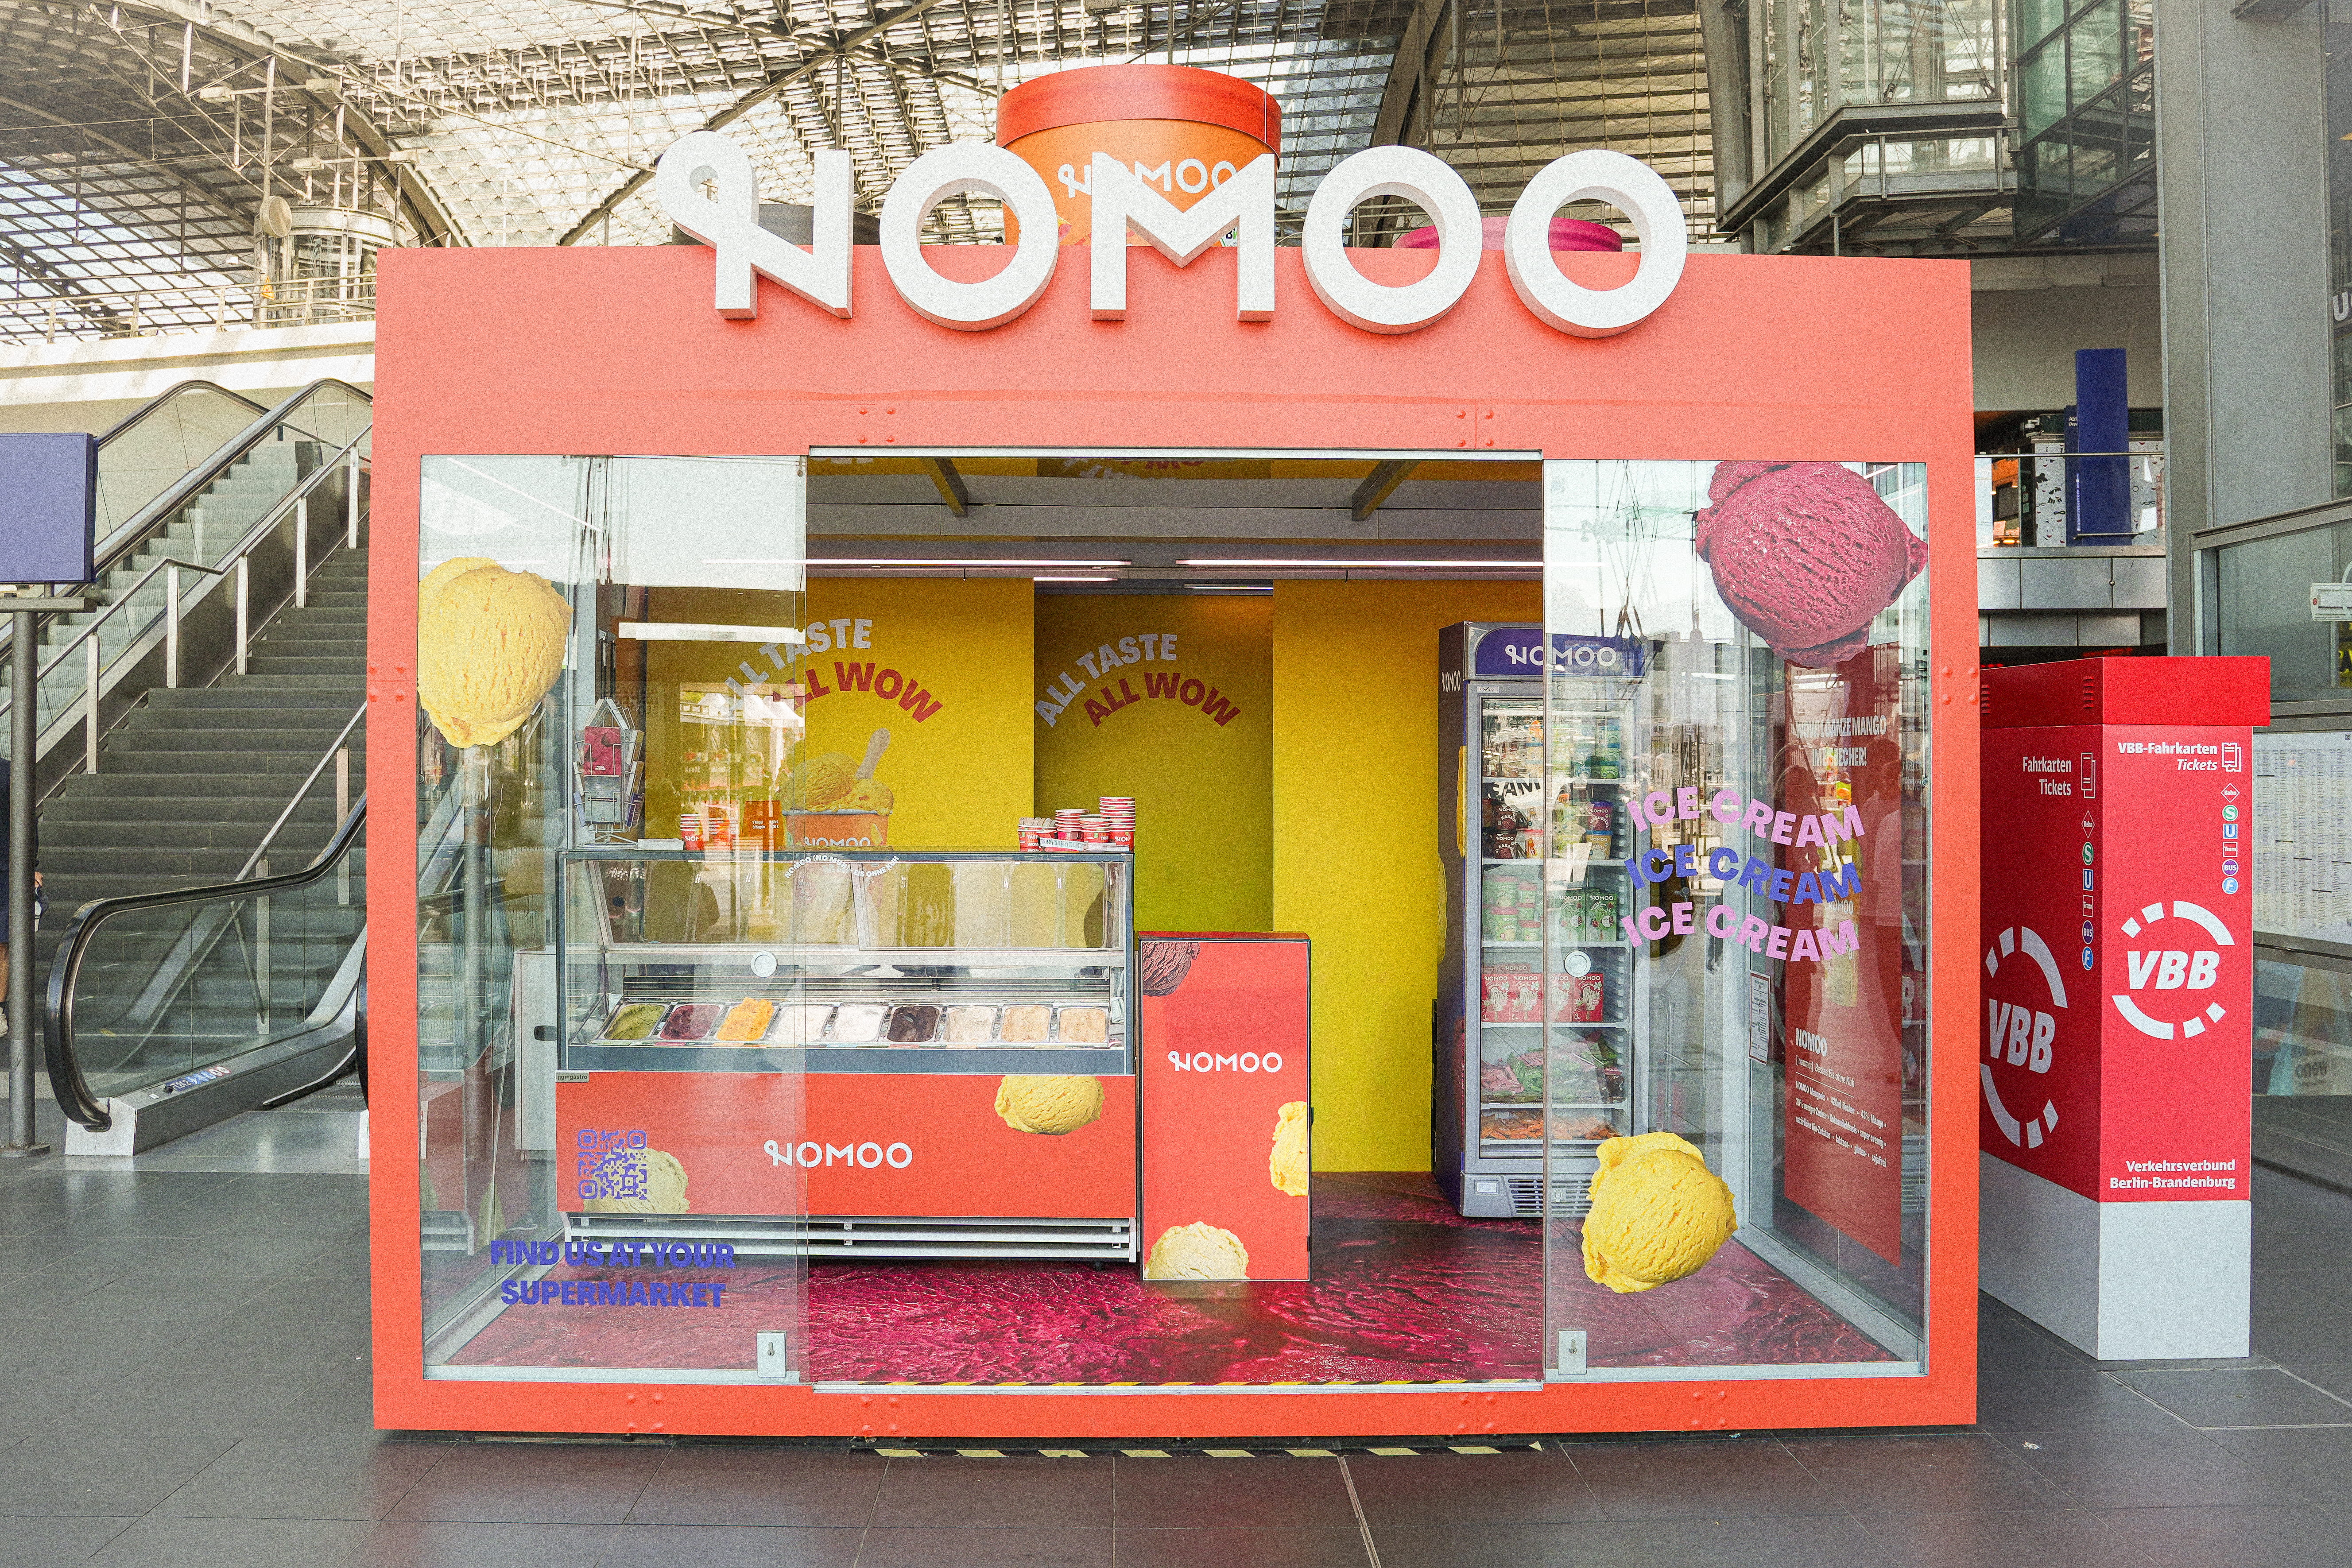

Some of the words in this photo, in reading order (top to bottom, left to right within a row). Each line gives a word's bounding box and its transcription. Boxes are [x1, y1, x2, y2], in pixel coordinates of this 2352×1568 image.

[1058, 158, 1240, 198] NMOO
[655, 132, 1688, 337] NOMOO
[1505, 644, 1617, 667] NOMOO
[834, 662, 943, 723] WOW
[1035, 671, 1086, 728] ALL
[1076, 633, 1177, 680] TASTE
[1441, 670, 1461, 693] NOMOO
[1083, 678, 1140, 728] ALL
[1144, 672, 1241, 728] WOW
[1852, 715, 1887, 736] MANGO
[2118, 742, 2218, 755] VBB-Fahrkarten
[2023, 756, 2071, 773] Fahrkarten
[2177, 759, 2218, 771] Tickets
[2039, 778, 2071, 796] Tickets
[1626, 786, 1700, 833] ICE
[1711, 790, 1865, 848] CREAM
[2226, 825, 2235, 837] U
[784, 856, 812, 879] NOMOO
[866, 867, 887, 877] OHNE
[886, 855, 899, 870] KUH
[1624, 844, 1698, 890] ICE
[1709, 846, 1862, 904] CREAM
[2085, 871, 2092, 888] U
[1621, 902, 1695, 948] ICE
[1706, 904, 1860, 962] CREAM
[2083, 928, 2092, 937] BUS
[2127, 951, 2220, 989] VBB
[1796, 1027, 1827, 1057] NOMOO
[1989, 998, 2055, 1074] VBB
[1168, 1050, 1283, 1073] NOMOO
[1835, 1072, 1845, 1084] ohne
[1846, 1076, 1855, 1088] Kuh
[763, 1139, 913, 1169] NOMOO
[2126, 1160, 2236, 1171] Verkehrsverbund
[2110, 1177, 2236, 1189] Berlin-Brandenburg
[490, 1239, 559, 1266] FIND
[564, 1240, 603, 1267] US
[603, 1241, 643, 1268] AT
[643, 1242, 736, 1269] YOUR
[500, 1279, 726, 1308] SUPERMARKET
